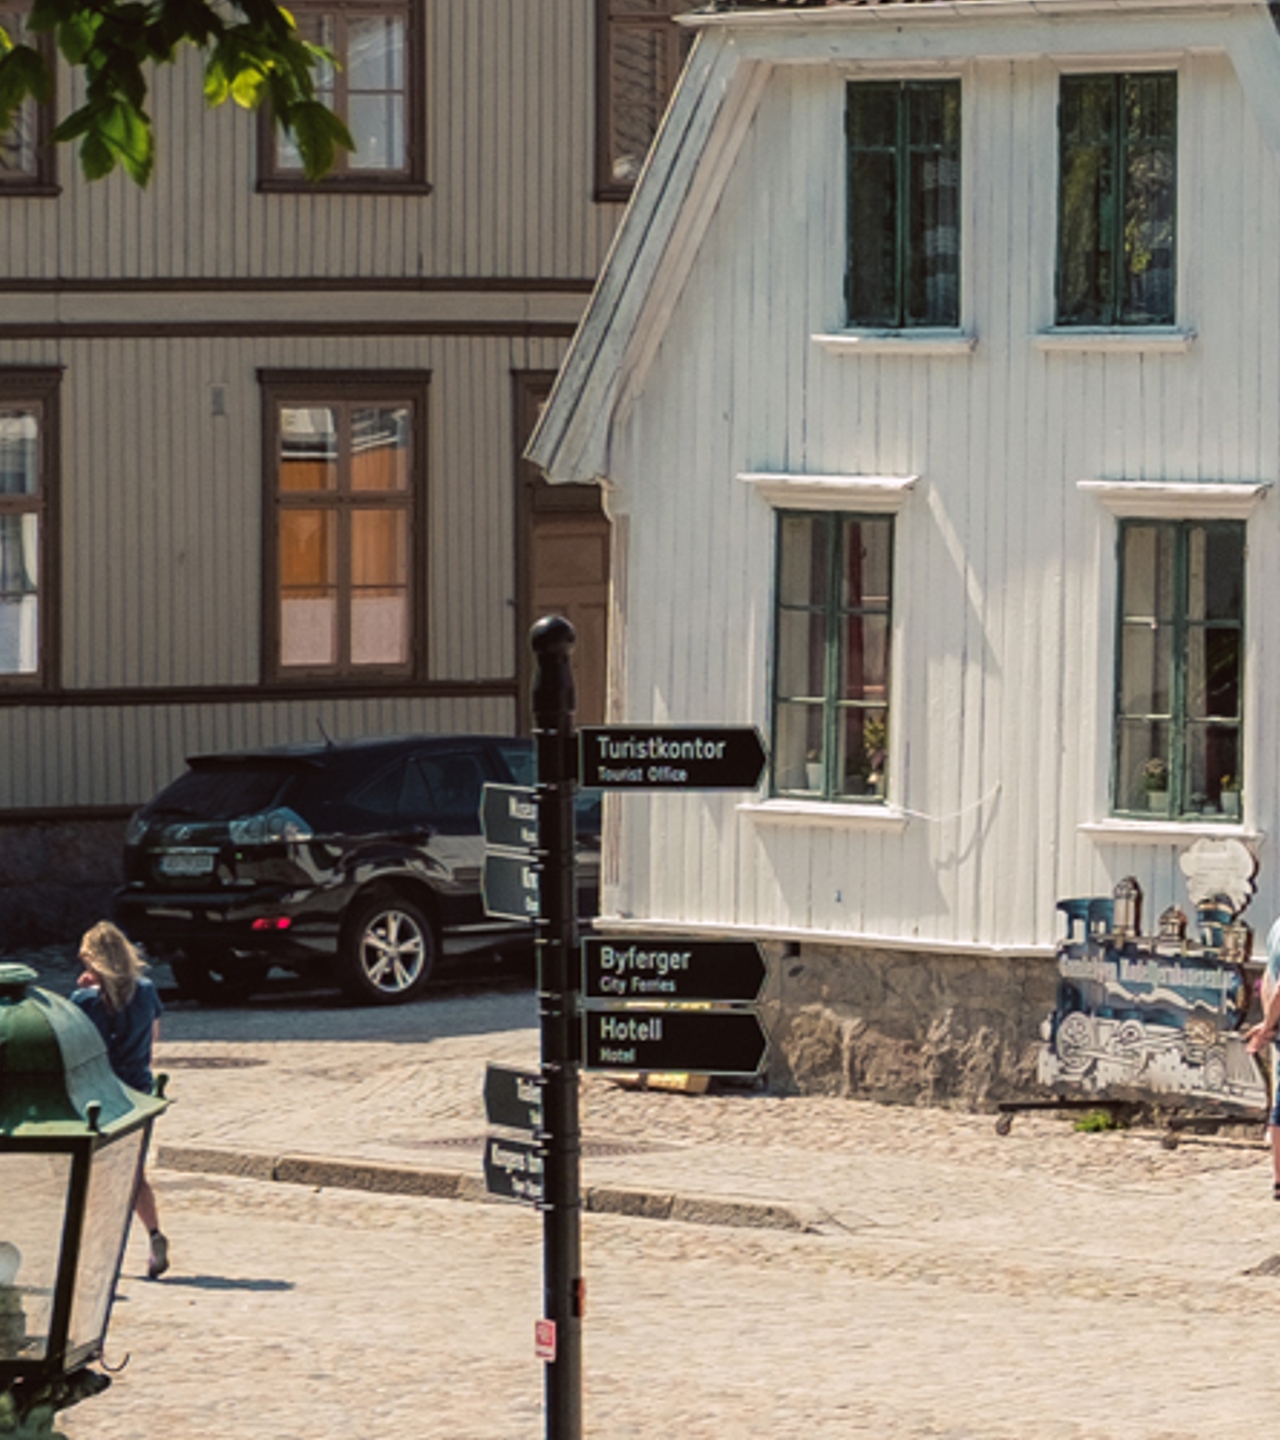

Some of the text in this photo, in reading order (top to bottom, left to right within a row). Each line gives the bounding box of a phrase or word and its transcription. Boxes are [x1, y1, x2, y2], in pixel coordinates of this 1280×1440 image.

[598, 737, 726, 759] Turistkontor
[598, 766, 688, 782] Tourist Office
[600, 946, 692, 974] Byferger
[600, 977, 676, 995] City Ferries
[600, 1017, 662, 1040] Hotell
[600, 1047, 636, 1063] Hotel
